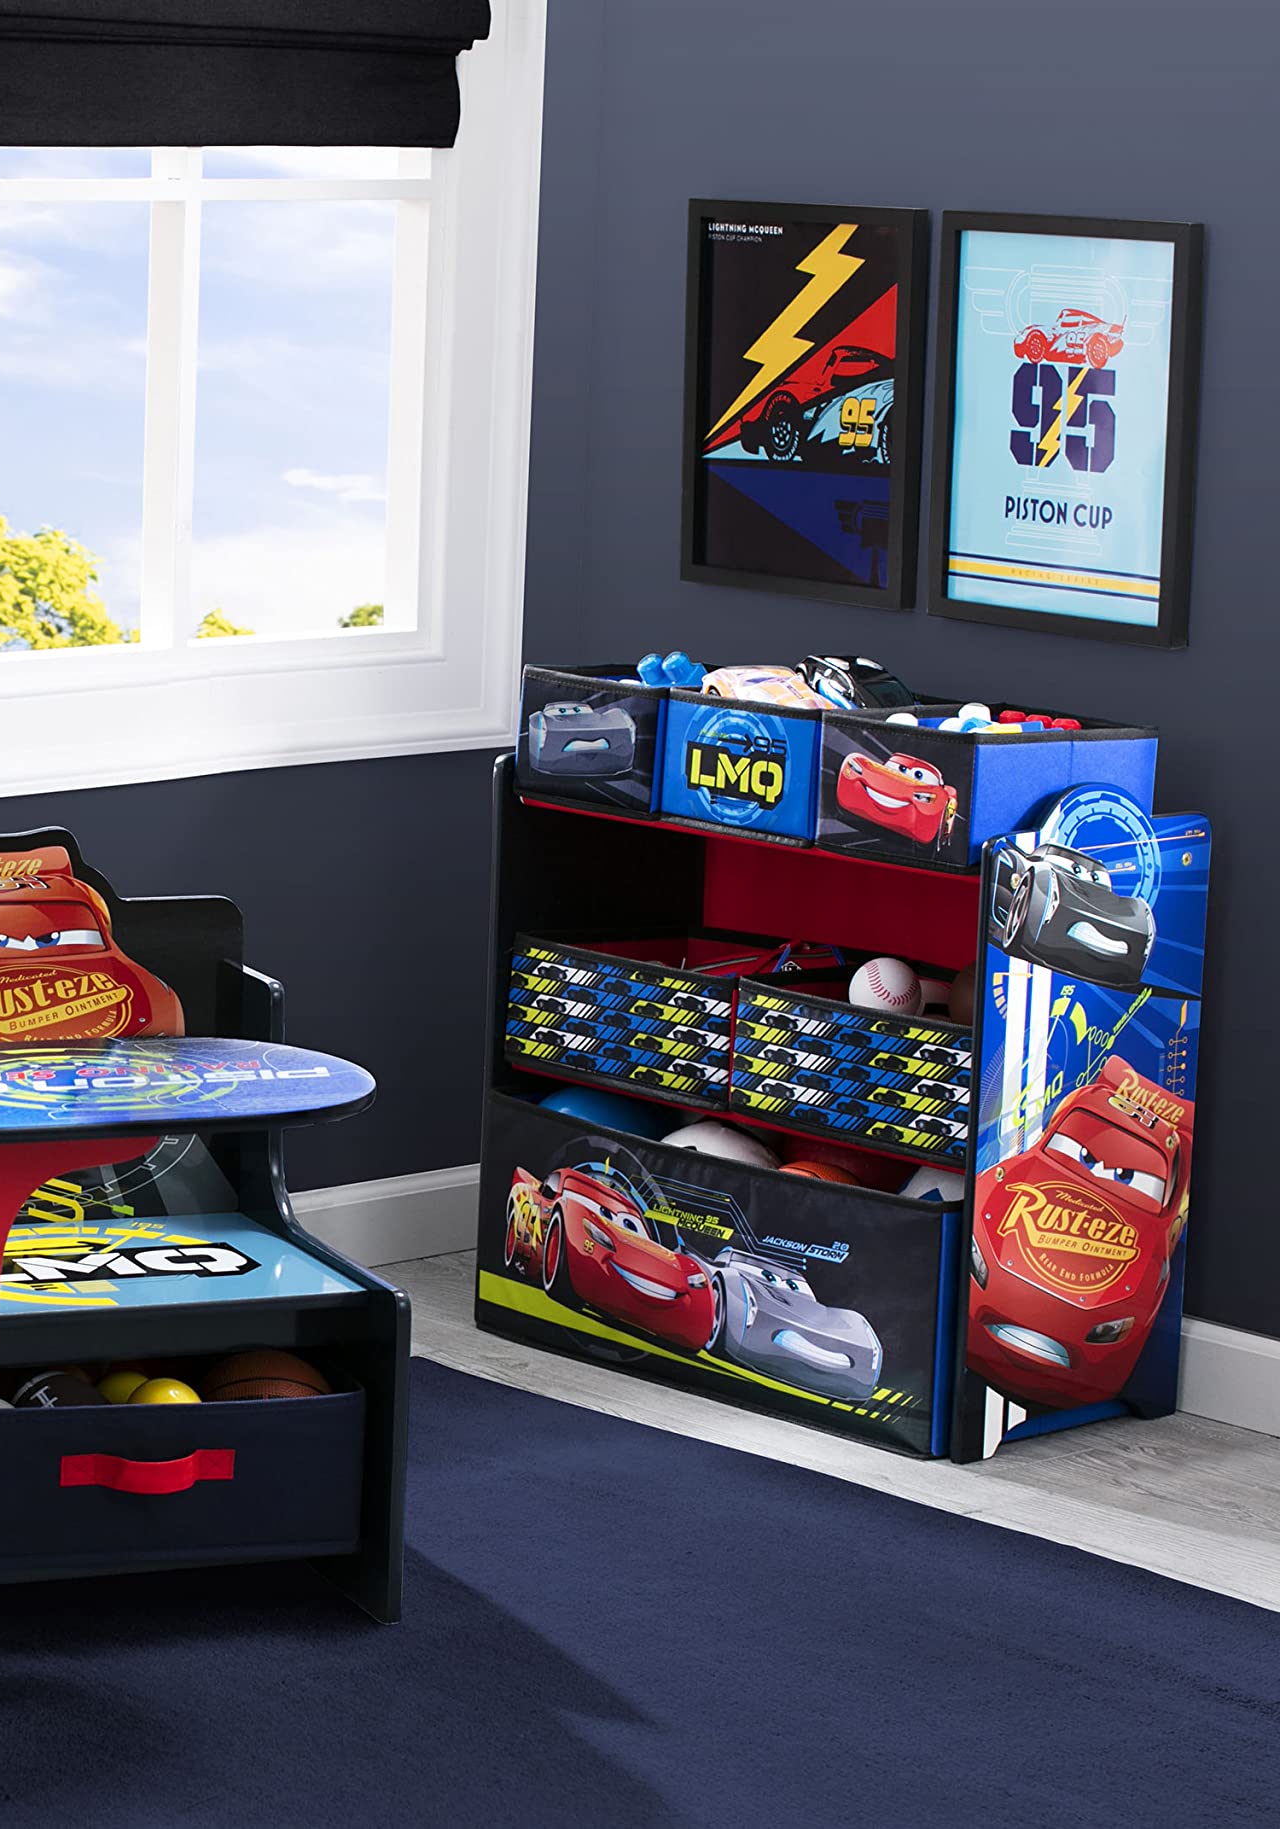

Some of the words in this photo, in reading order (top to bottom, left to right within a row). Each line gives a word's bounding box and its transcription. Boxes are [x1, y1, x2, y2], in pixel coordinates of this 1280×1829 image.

[708, 222, 747, 234] LIGHTNING
[748, 225, 784, 236] MCQUEEN
[839, 397, 877, 447] 95
[1010, 363, 1117, 473] 95
[1005, 496, 1068, 525] PISTON
[1074, 504, 1113, 529] CUP
[690, 748, 783, 803] LMQ
[653, 1203, 704, 1224] LIGHTNING
[705, 1214, 719, 1225] 95
[762, 1235, 808, 1252] JACKSON
[808, 1246, 845, 1261] STORM
